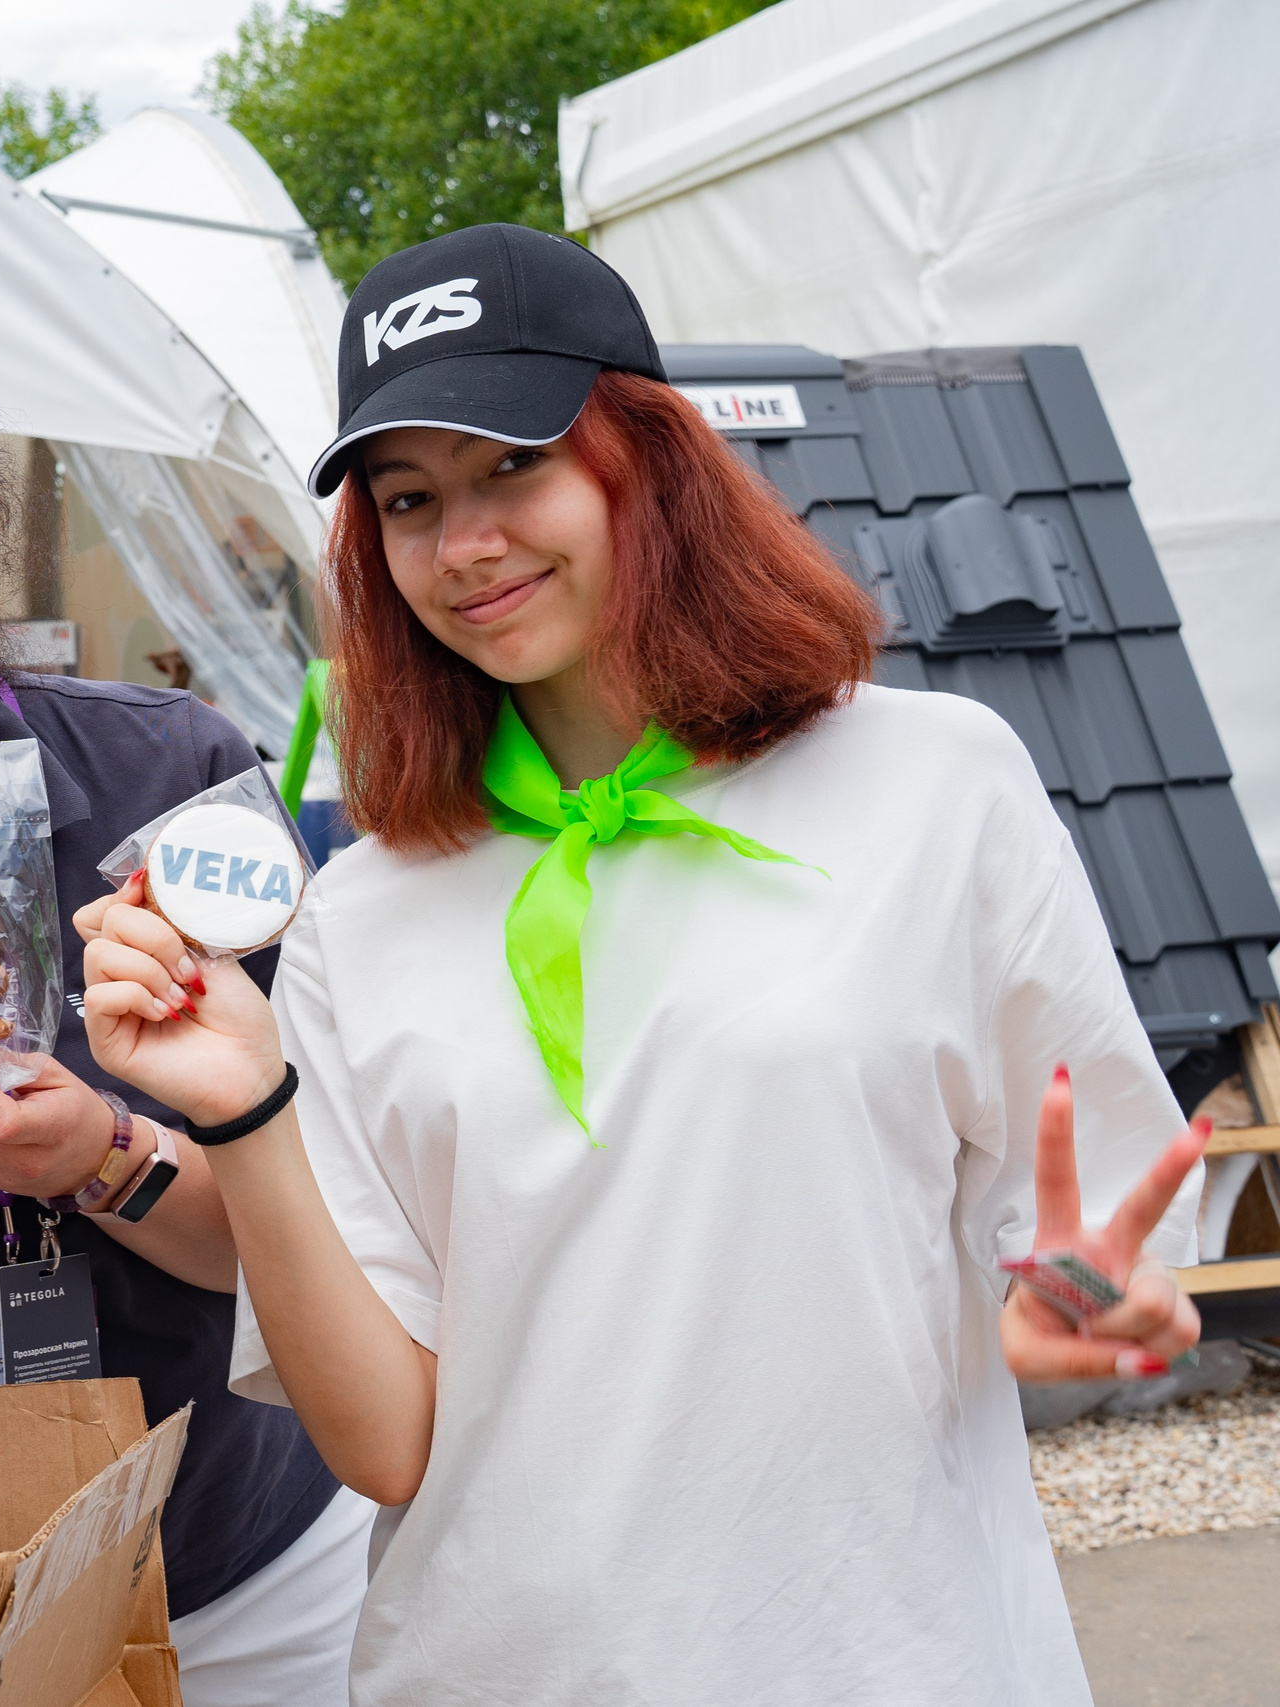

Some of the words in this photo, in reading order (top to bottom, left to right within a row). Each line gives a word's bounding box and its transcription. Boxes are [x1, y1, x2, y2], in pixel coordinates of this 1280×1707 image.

[363, 277, 482, 367] KZS
[161, 844, 292, 906] VEKA
[24, 1286, 65, 1303] TEGOLA
[63, 1339, 88, 1350] Марина
